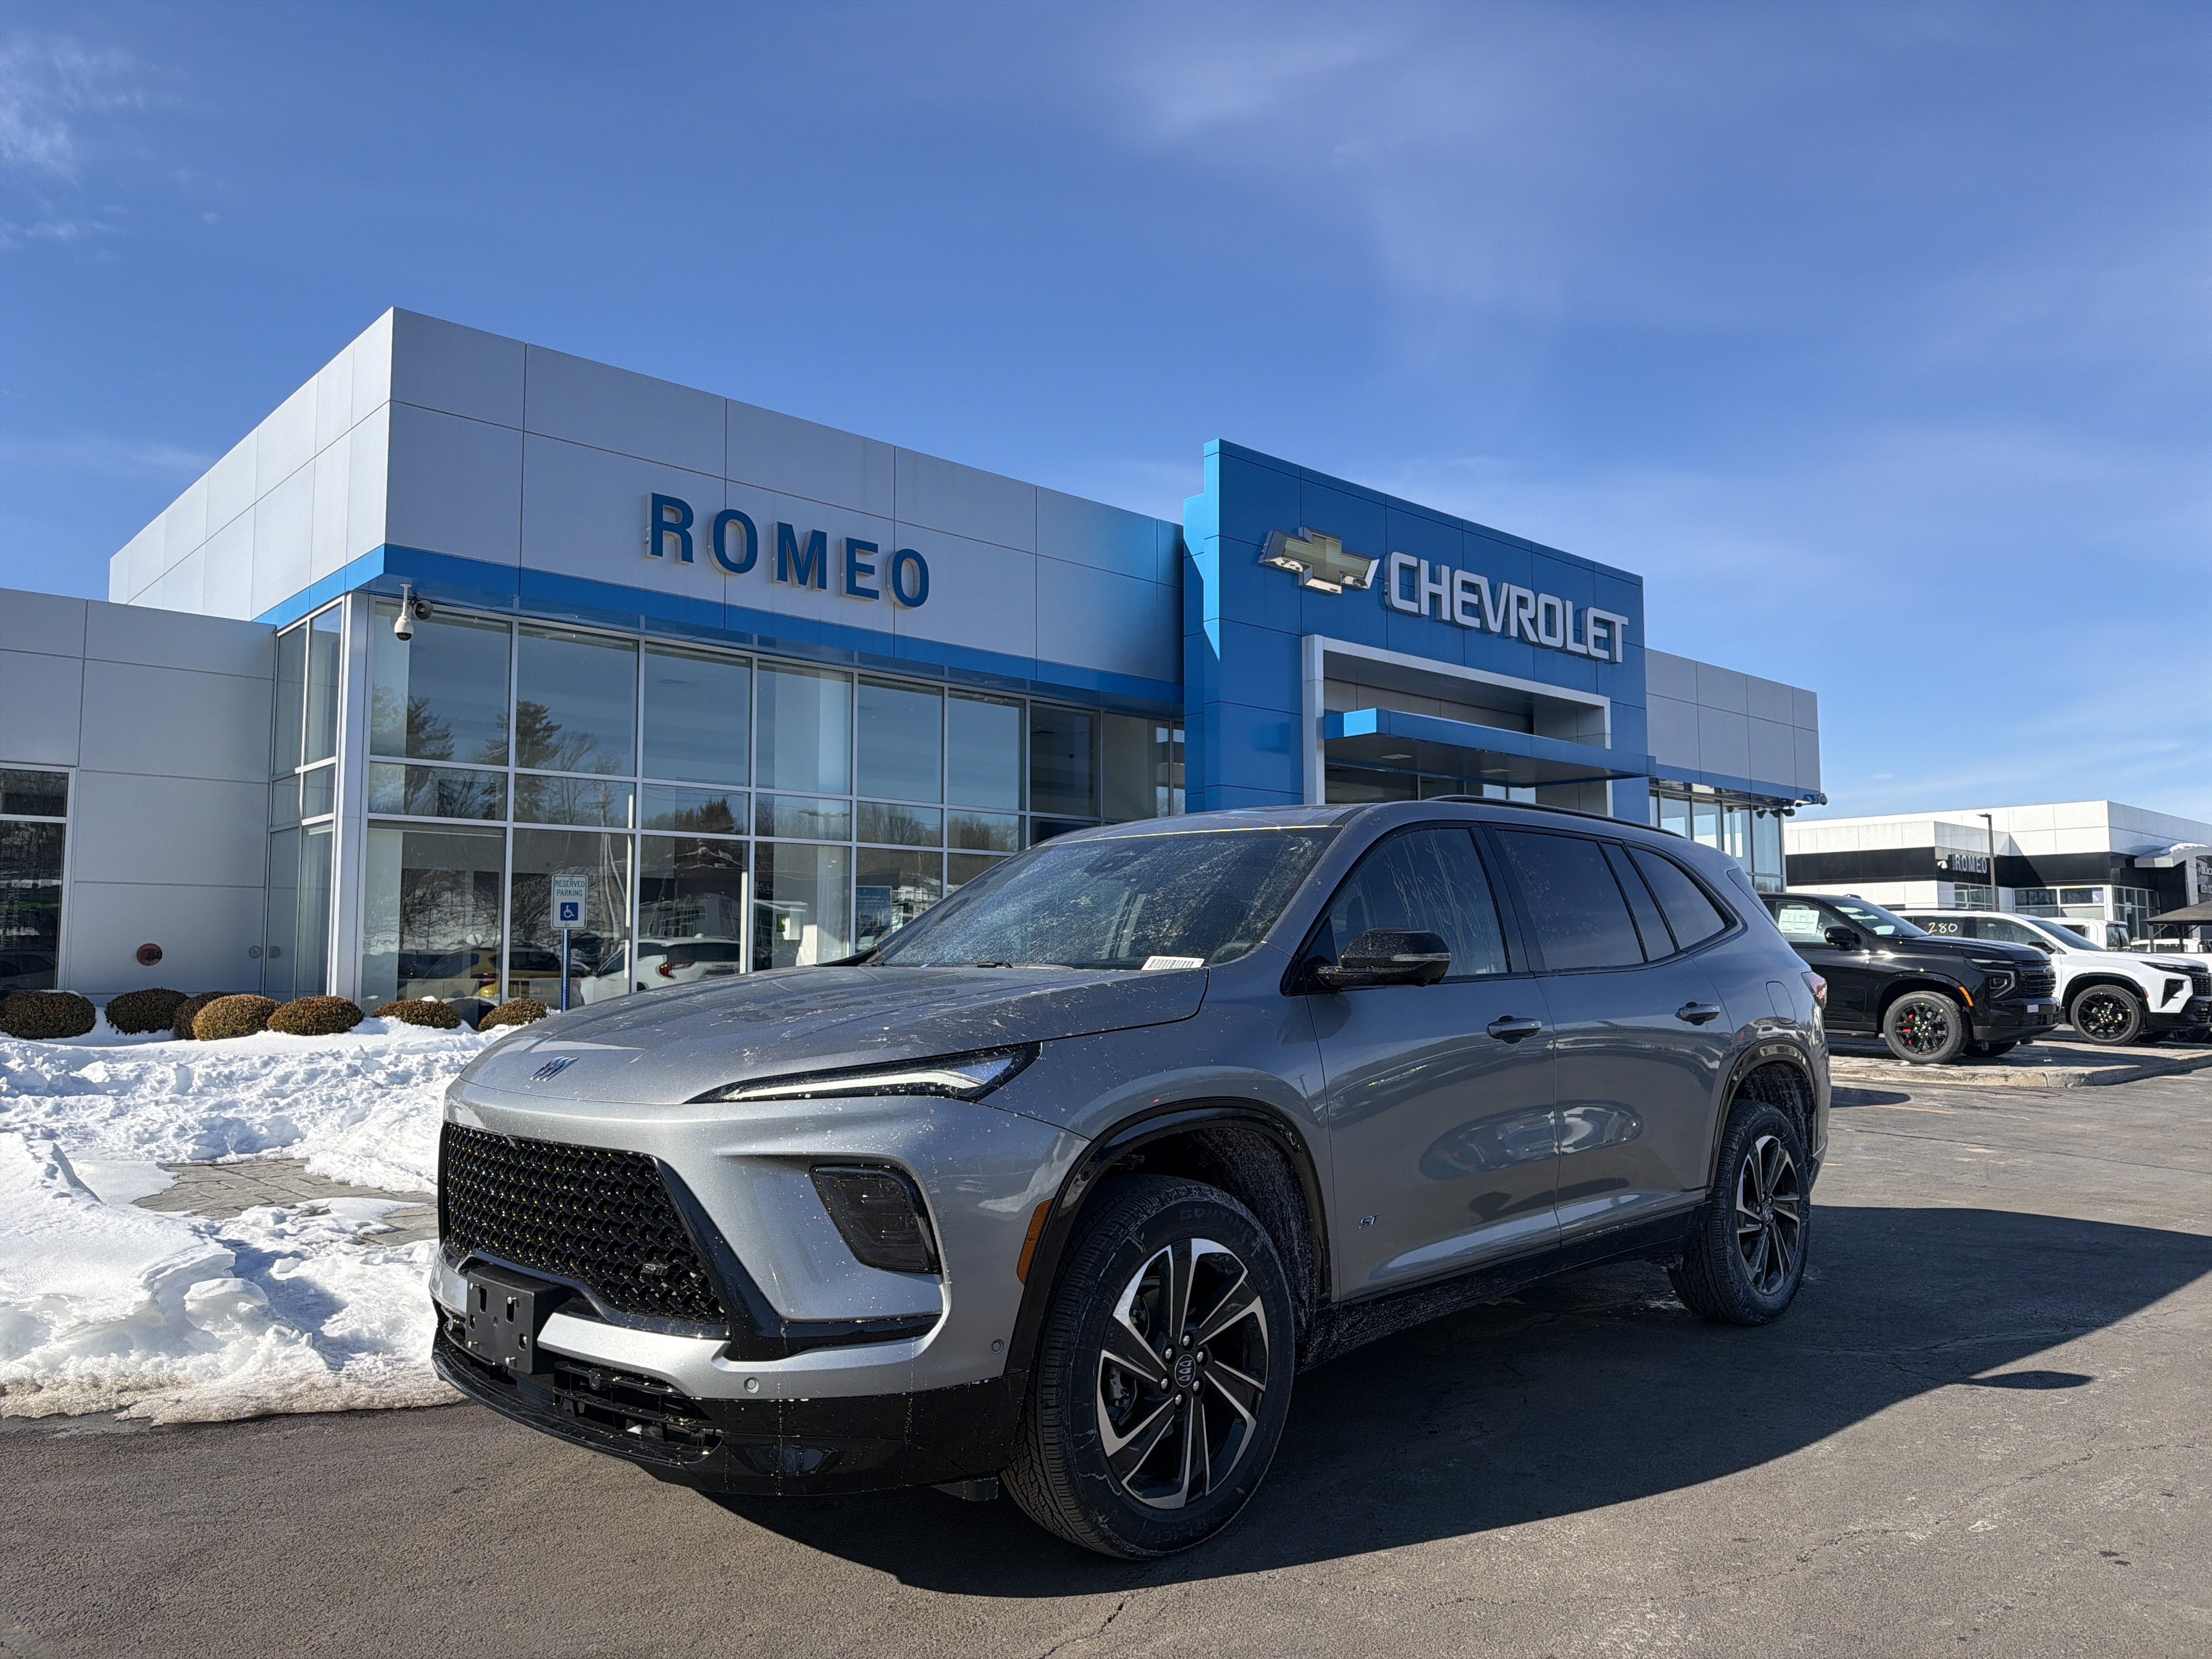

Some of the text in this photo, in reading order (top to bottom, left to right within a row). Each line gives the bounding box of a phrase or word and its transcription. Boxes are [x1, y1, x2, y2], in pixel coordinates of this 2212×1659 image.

[646, 493, 929, 608] ROMEO
[1384, 551, 1628, 663] CHEVROLET
[1954, 854, 1987, 874] ROMEO
[2201, 867, 2212, 875] BUIC
[556, 889, 583, 897] PARKING
[1927, 922, 1958, 935] 280
[1358, 1212, 1380, 1229] ST
